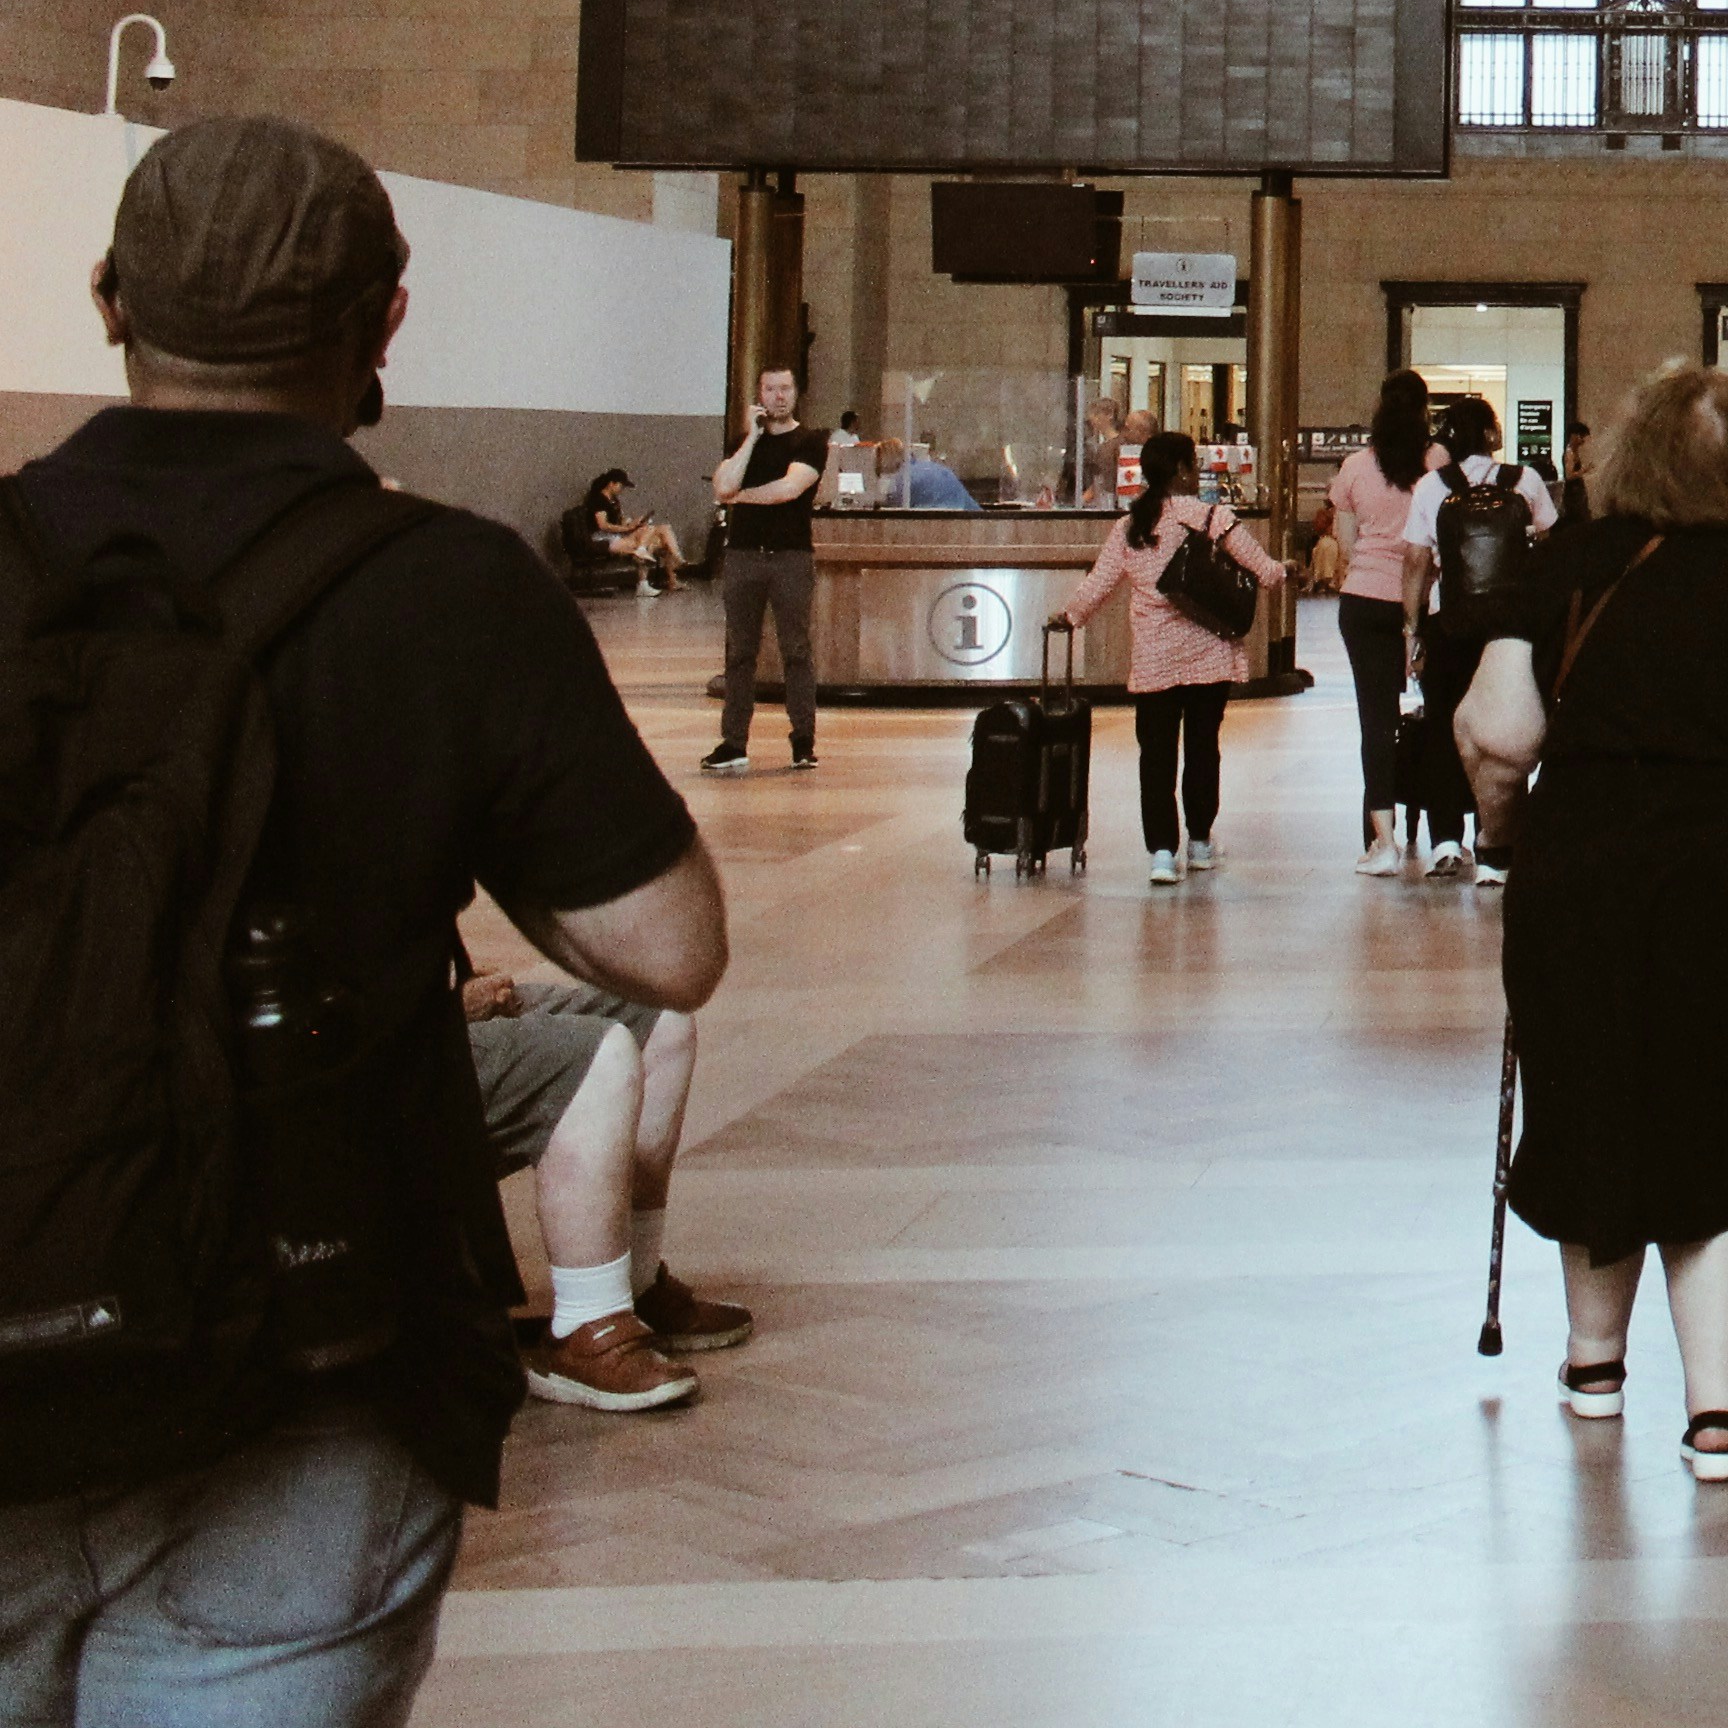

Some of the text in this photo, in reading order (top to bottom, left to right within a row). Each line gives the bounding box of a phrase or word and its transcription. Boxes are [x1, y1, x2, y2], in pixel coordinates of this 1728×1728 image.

[1138, 279, 1229, 289] TRAVELLERS AID
[1159, 292, 1204, 302] SOCIETY
